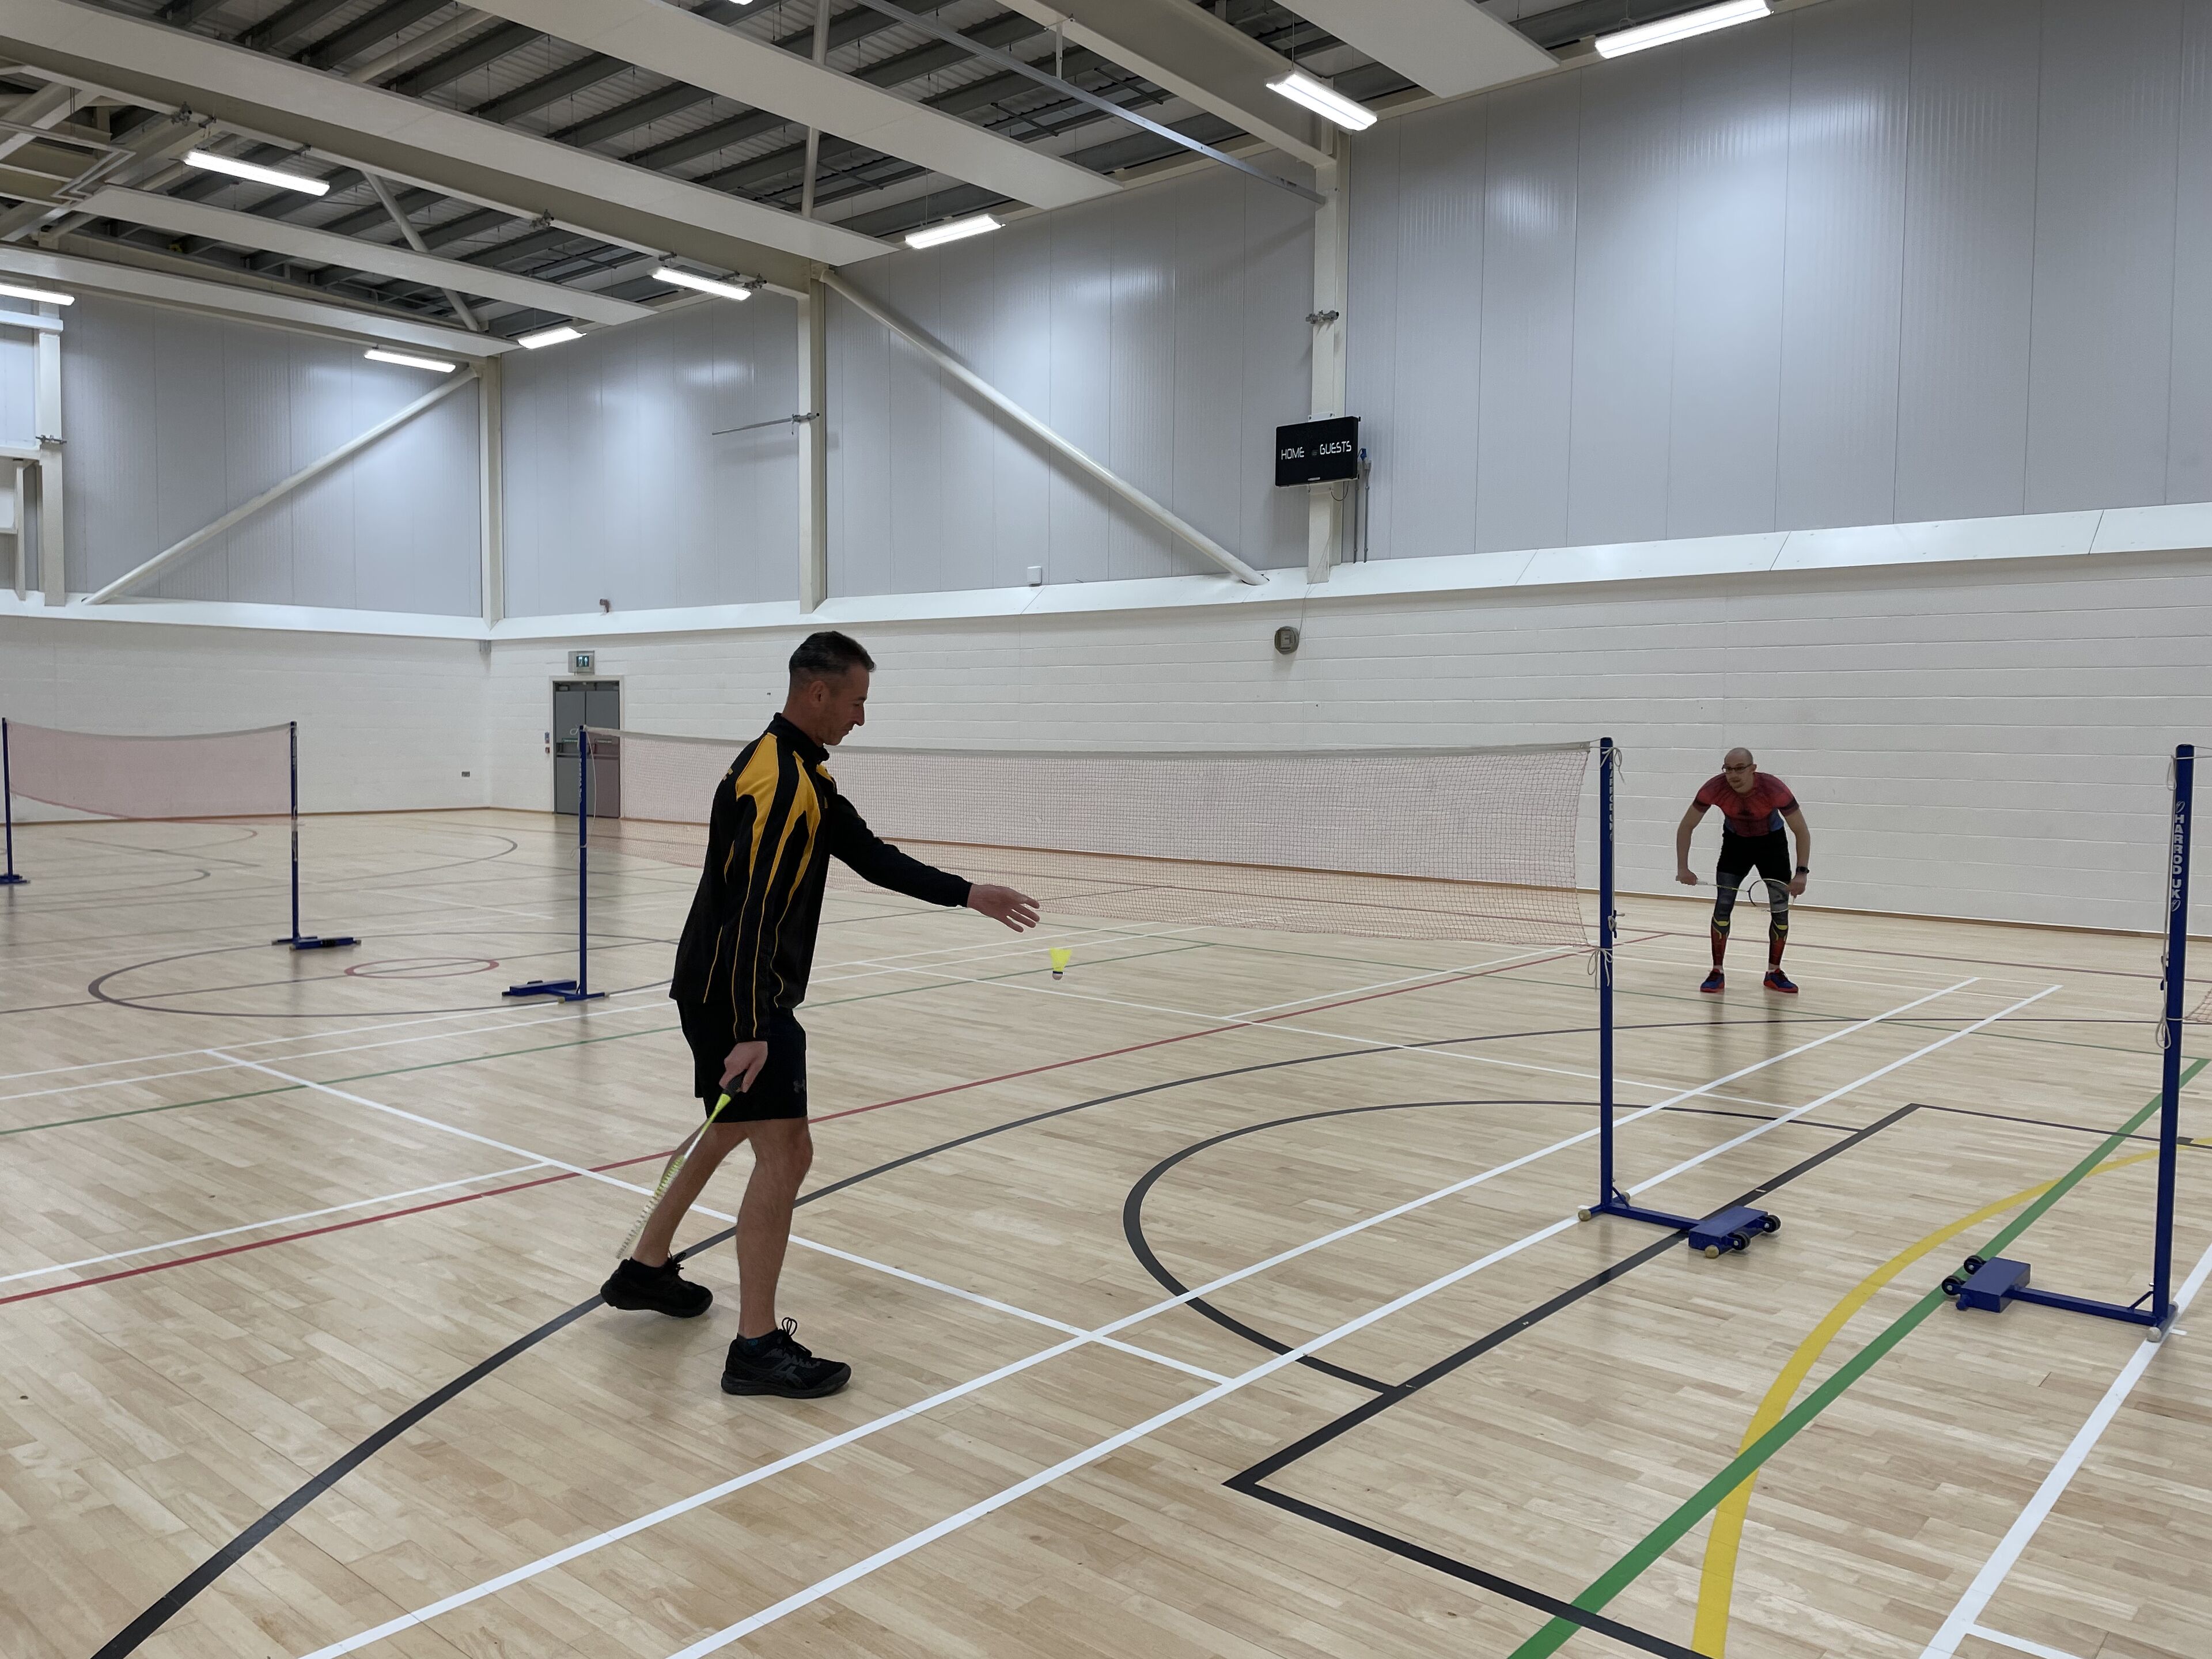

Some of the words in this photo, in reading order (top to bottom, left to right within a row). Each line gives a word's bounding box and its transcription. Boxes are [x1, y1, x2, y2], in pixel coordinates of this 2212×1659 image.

[1281, 446, 1305, 460] HOME
[1320, 441, 1351, 455] GUESTS
[2172, 814, 2184, 874] HARROD
[2171, 878, 2181, 899] UK
